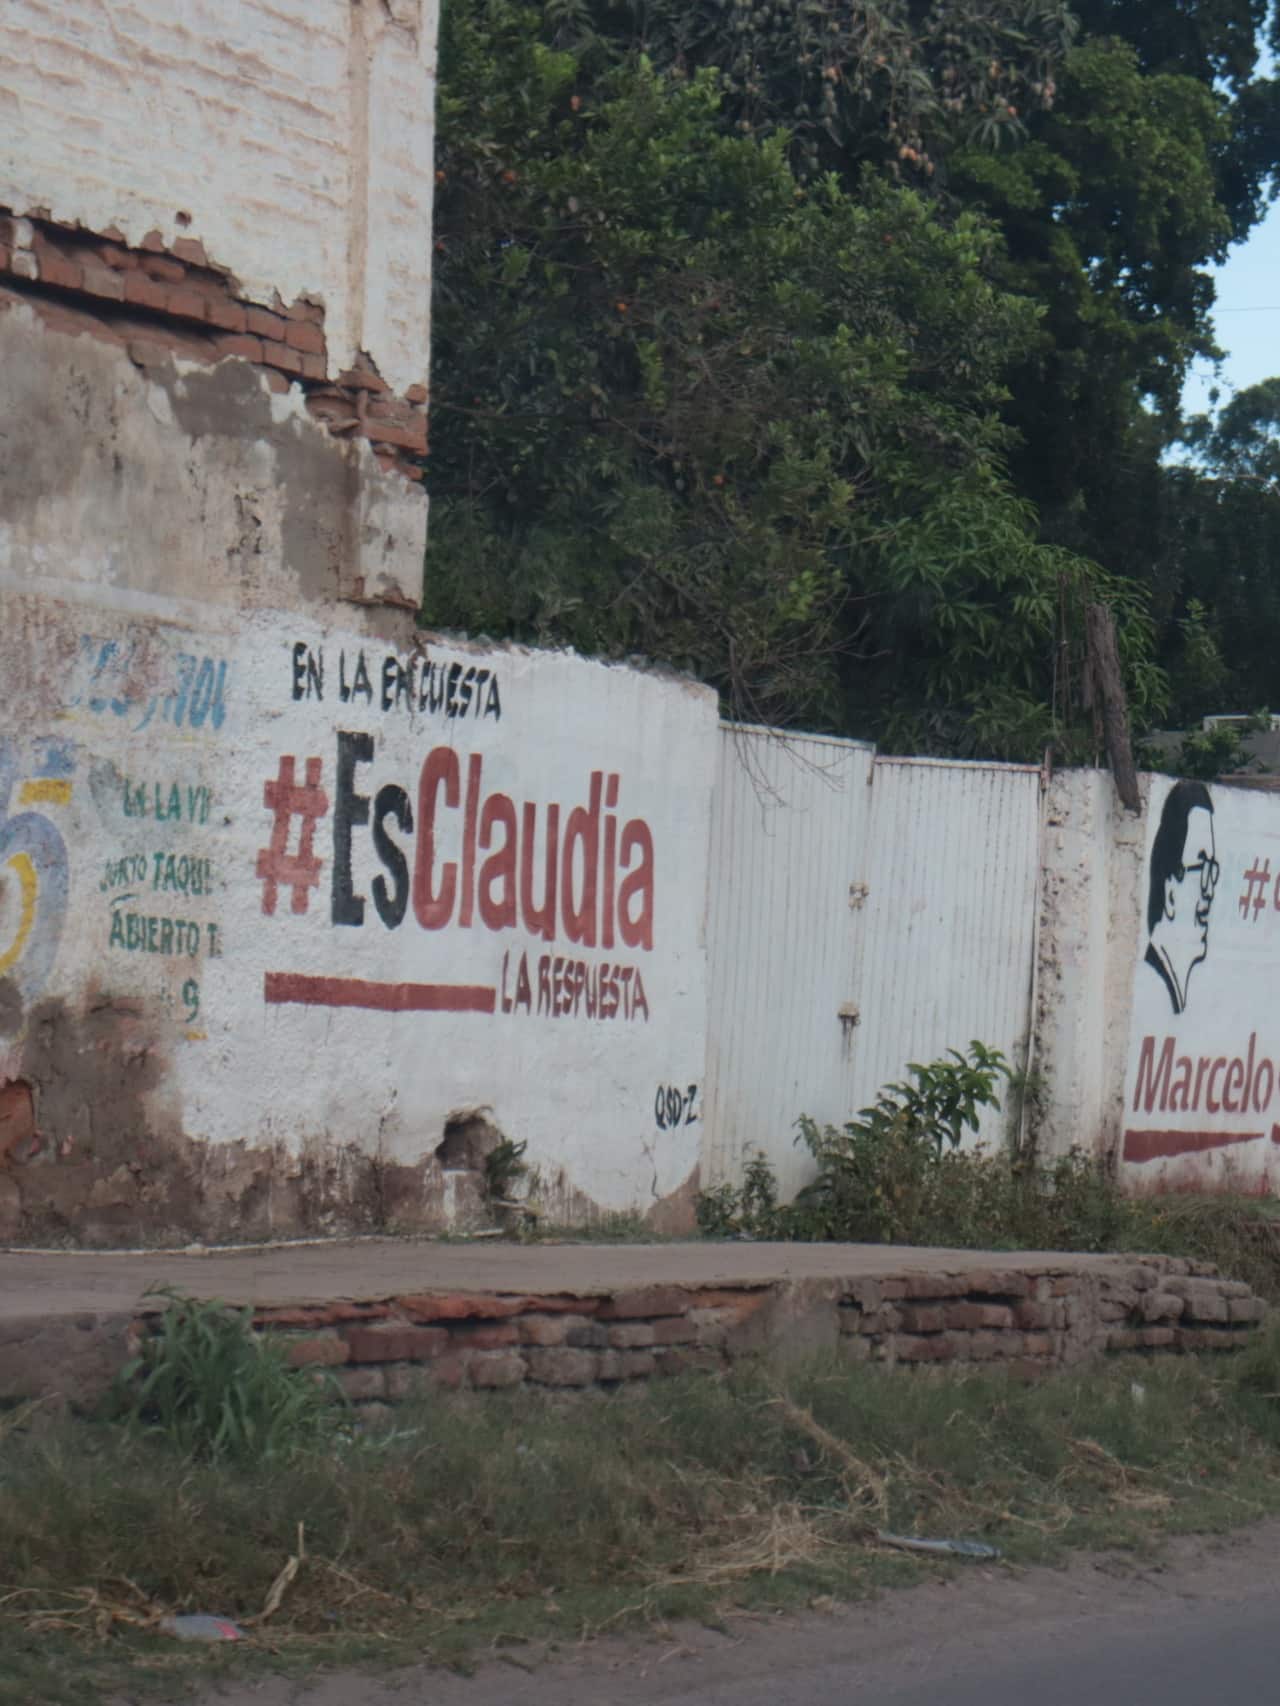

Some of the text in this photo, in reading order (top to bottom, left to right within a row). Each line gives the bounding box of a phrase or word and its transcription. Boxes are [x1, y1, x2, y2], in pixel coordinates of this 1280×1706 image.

[292, 641, 323, 702] EN
[339, 647, 373, 704] LA
[381, 655, 501, 722] ENCUESTA
[256, 730, 654, 951] #EsClaudia
[109, 909, 200, 958] ABIERTO
[501, 949, 650, 1023] LA RESPUESTA
